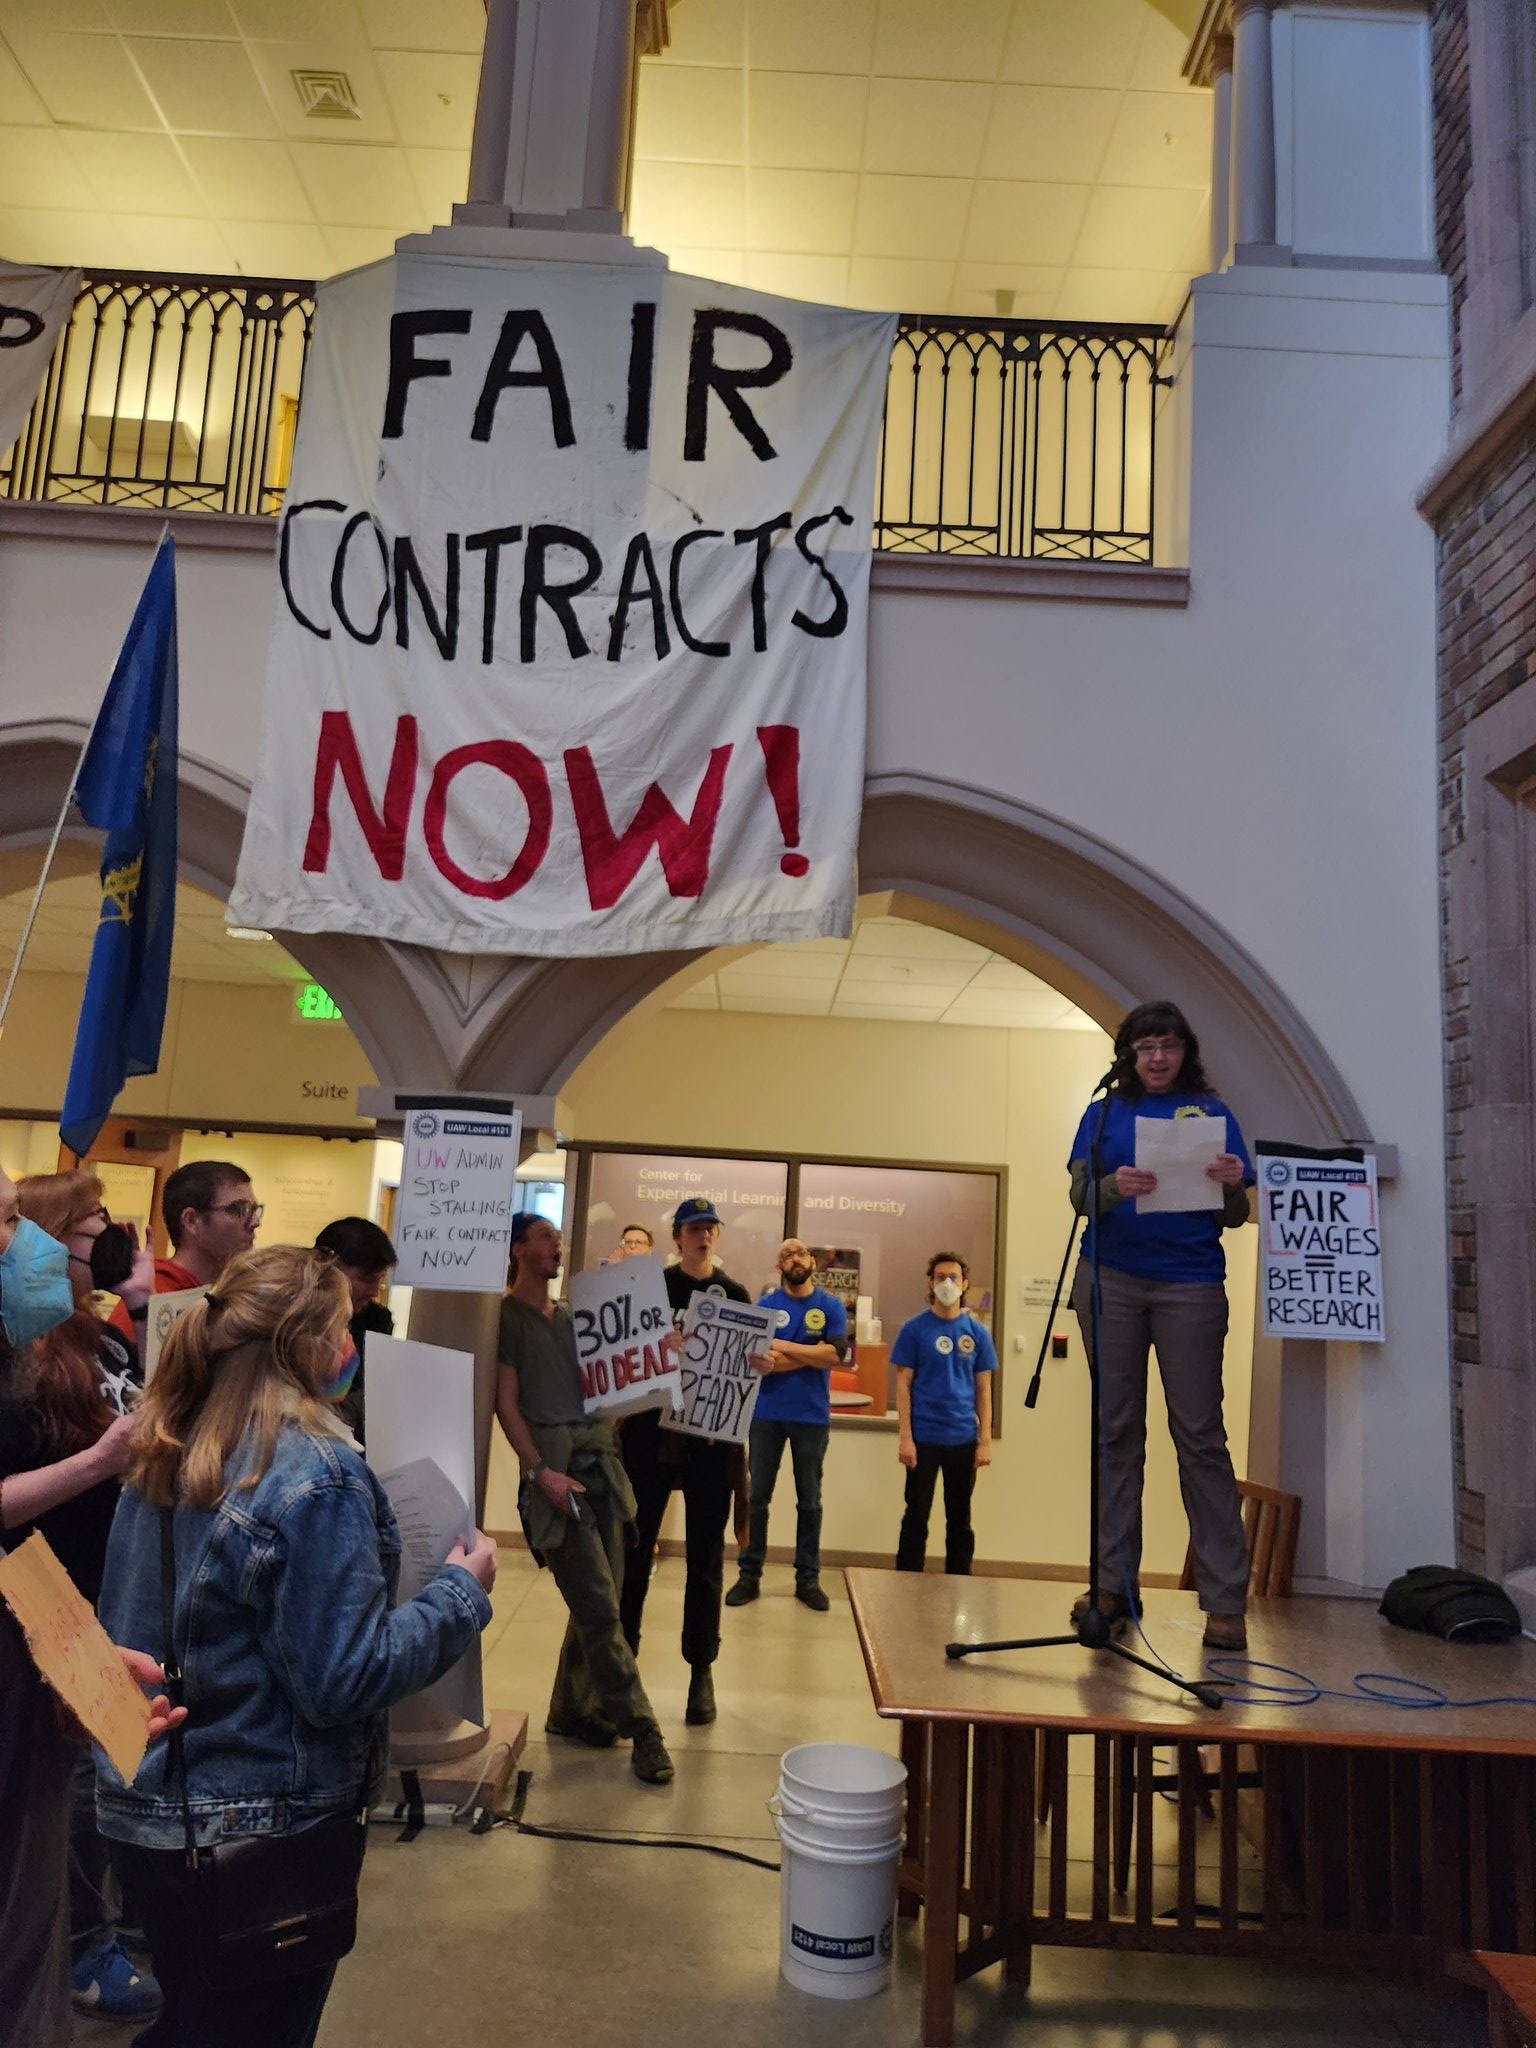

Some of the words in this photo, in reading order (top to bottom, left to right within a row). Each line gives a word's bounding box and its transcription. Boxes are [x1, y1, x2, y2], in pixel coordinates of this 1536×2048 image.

[381, 301, 794, 463] FAIR
[278, 499, 855, 665] CONTRACTS
[302, 710, 811, 912] NOW!
[302, 1080, 349, 1099] Suite
[447, 1123, 468, 1132] UAW
[468, 1124, 490, 1134] Local
[416, 1148, 451, 1169] UW
[456, 1149, 504, 1169] ADMIN
[414, 1177, 461, 1196] STOP
[639, 1168, 680, 1182] Center
[684, 1170, 704, 1182] for
[804, 1196, 834, 1210] and
[839, 1196, 906, 1217] Diversity
[1268, 1189, 1349, 1223] FAIR
[402, 1224, 439, 1242] FAIR
[448, 1226, 511, 1243] CONTRACT
[1280, 1224, 1380, 1256] WAGES
[422, 1247, 476, 1268] NOW
[1268, 1267, 1375, 1297] BETTER
[640, 1306, 667, 1331] OR
[1268, 1297, 1380, 1331] RESEARCH
[577, 1359, 610, 1399] NO
[611, 1335, 679, 1390] DEAL
